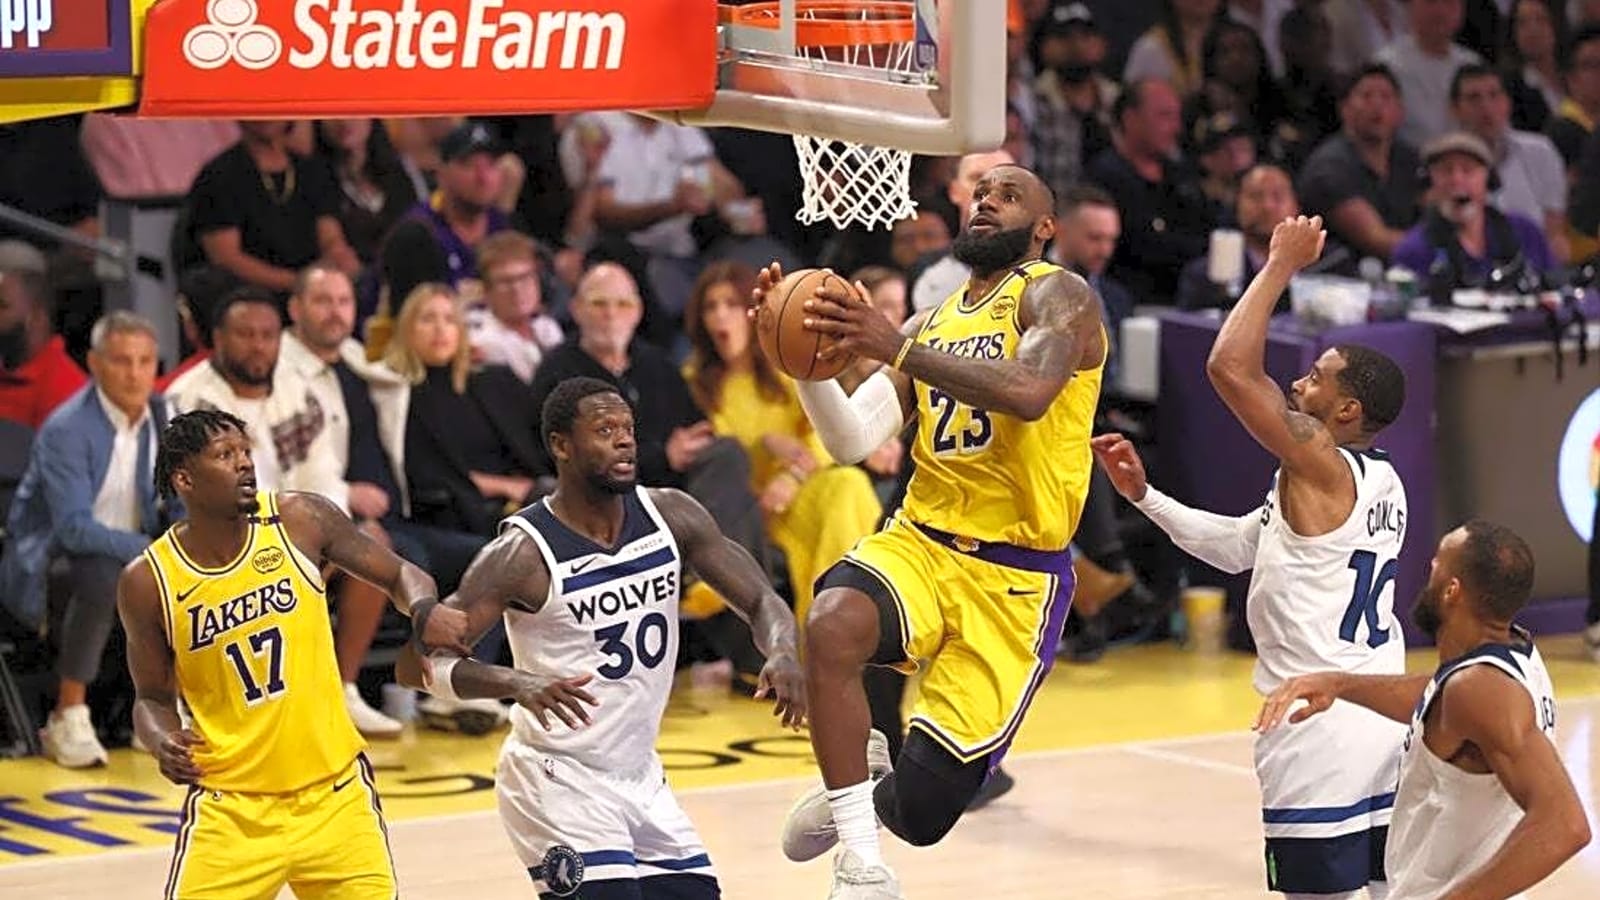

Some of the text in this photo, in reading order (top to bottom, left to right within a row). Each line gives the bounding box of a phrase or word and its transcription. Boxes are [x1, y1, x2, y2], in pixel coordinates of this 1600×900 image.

[930, 387, 992, 452] 23
[1366, 500, 1405, 543] CONLE
[187, 578, 297, 651] LAKERS
[566, 571, 675, 625] WOLVES
[226, 627, 285, 702] 17
[594, 612, 668, 680] 30
